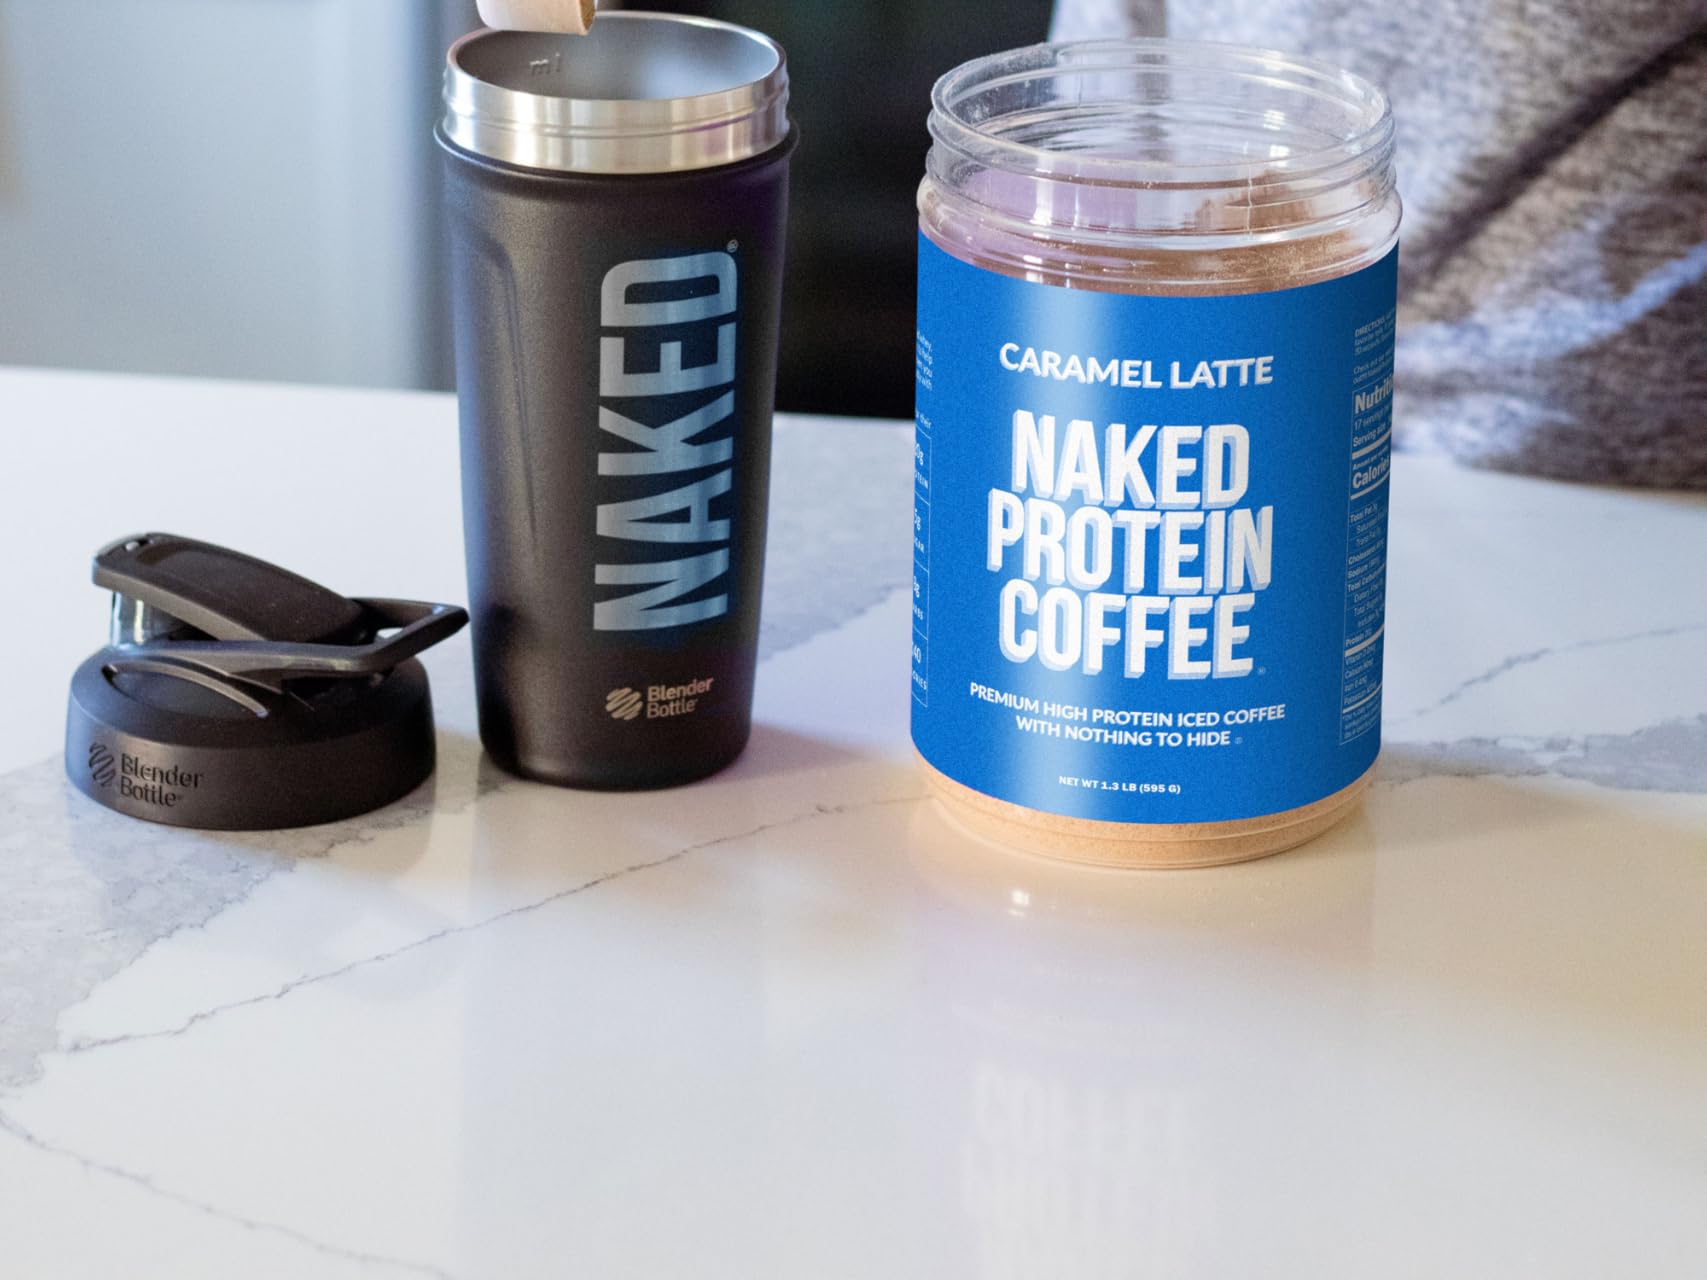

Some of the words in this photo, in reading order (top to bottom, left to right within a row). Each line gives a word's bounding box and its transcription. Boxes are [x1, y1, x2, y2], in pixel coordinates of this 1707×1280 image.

[999, 343, 1162, 389] CARAMEL
[1171, 356, 1274, 390] LATTE
[593, 249, 739, 632] NAKED
[1012, 409, 1249, 510] NAKED
[987, 489, 1274, 595] PROTEIN
[999, 578, 1256, 680] COFFEE
[647, 677, 714, 701] Blender
[647, 699, 697, 719] Bottle
[970, 683, 1039, 713] PREMIUM
[1044, 702, 1088, 720] HIGH
[1093, 709, 1170, 728] PROTEIN
[1177, 711, 1219, 728] ICED
[1223, 704, 1286, 726] COFFEE
[1016, 717, 1062, 738] WITH
[1065, 728, 1154, 747] NOTHING
[1157, 732, 1182, 747] TO
[1186, 730, 1231, 746] HIDE
[121, 753, 203, 788] Blender
[1059, 775, 1079, 786] NET
[1081, 778, 1099, 789] WT
[1101, 780, 1119, 791] 1.3
[1121, 782, 1137, 792] LB
[1139, 782, 1166, 794] (595
[1168, 782, 1181, 794] G)
[121, 776, 178, 807] Bottle
